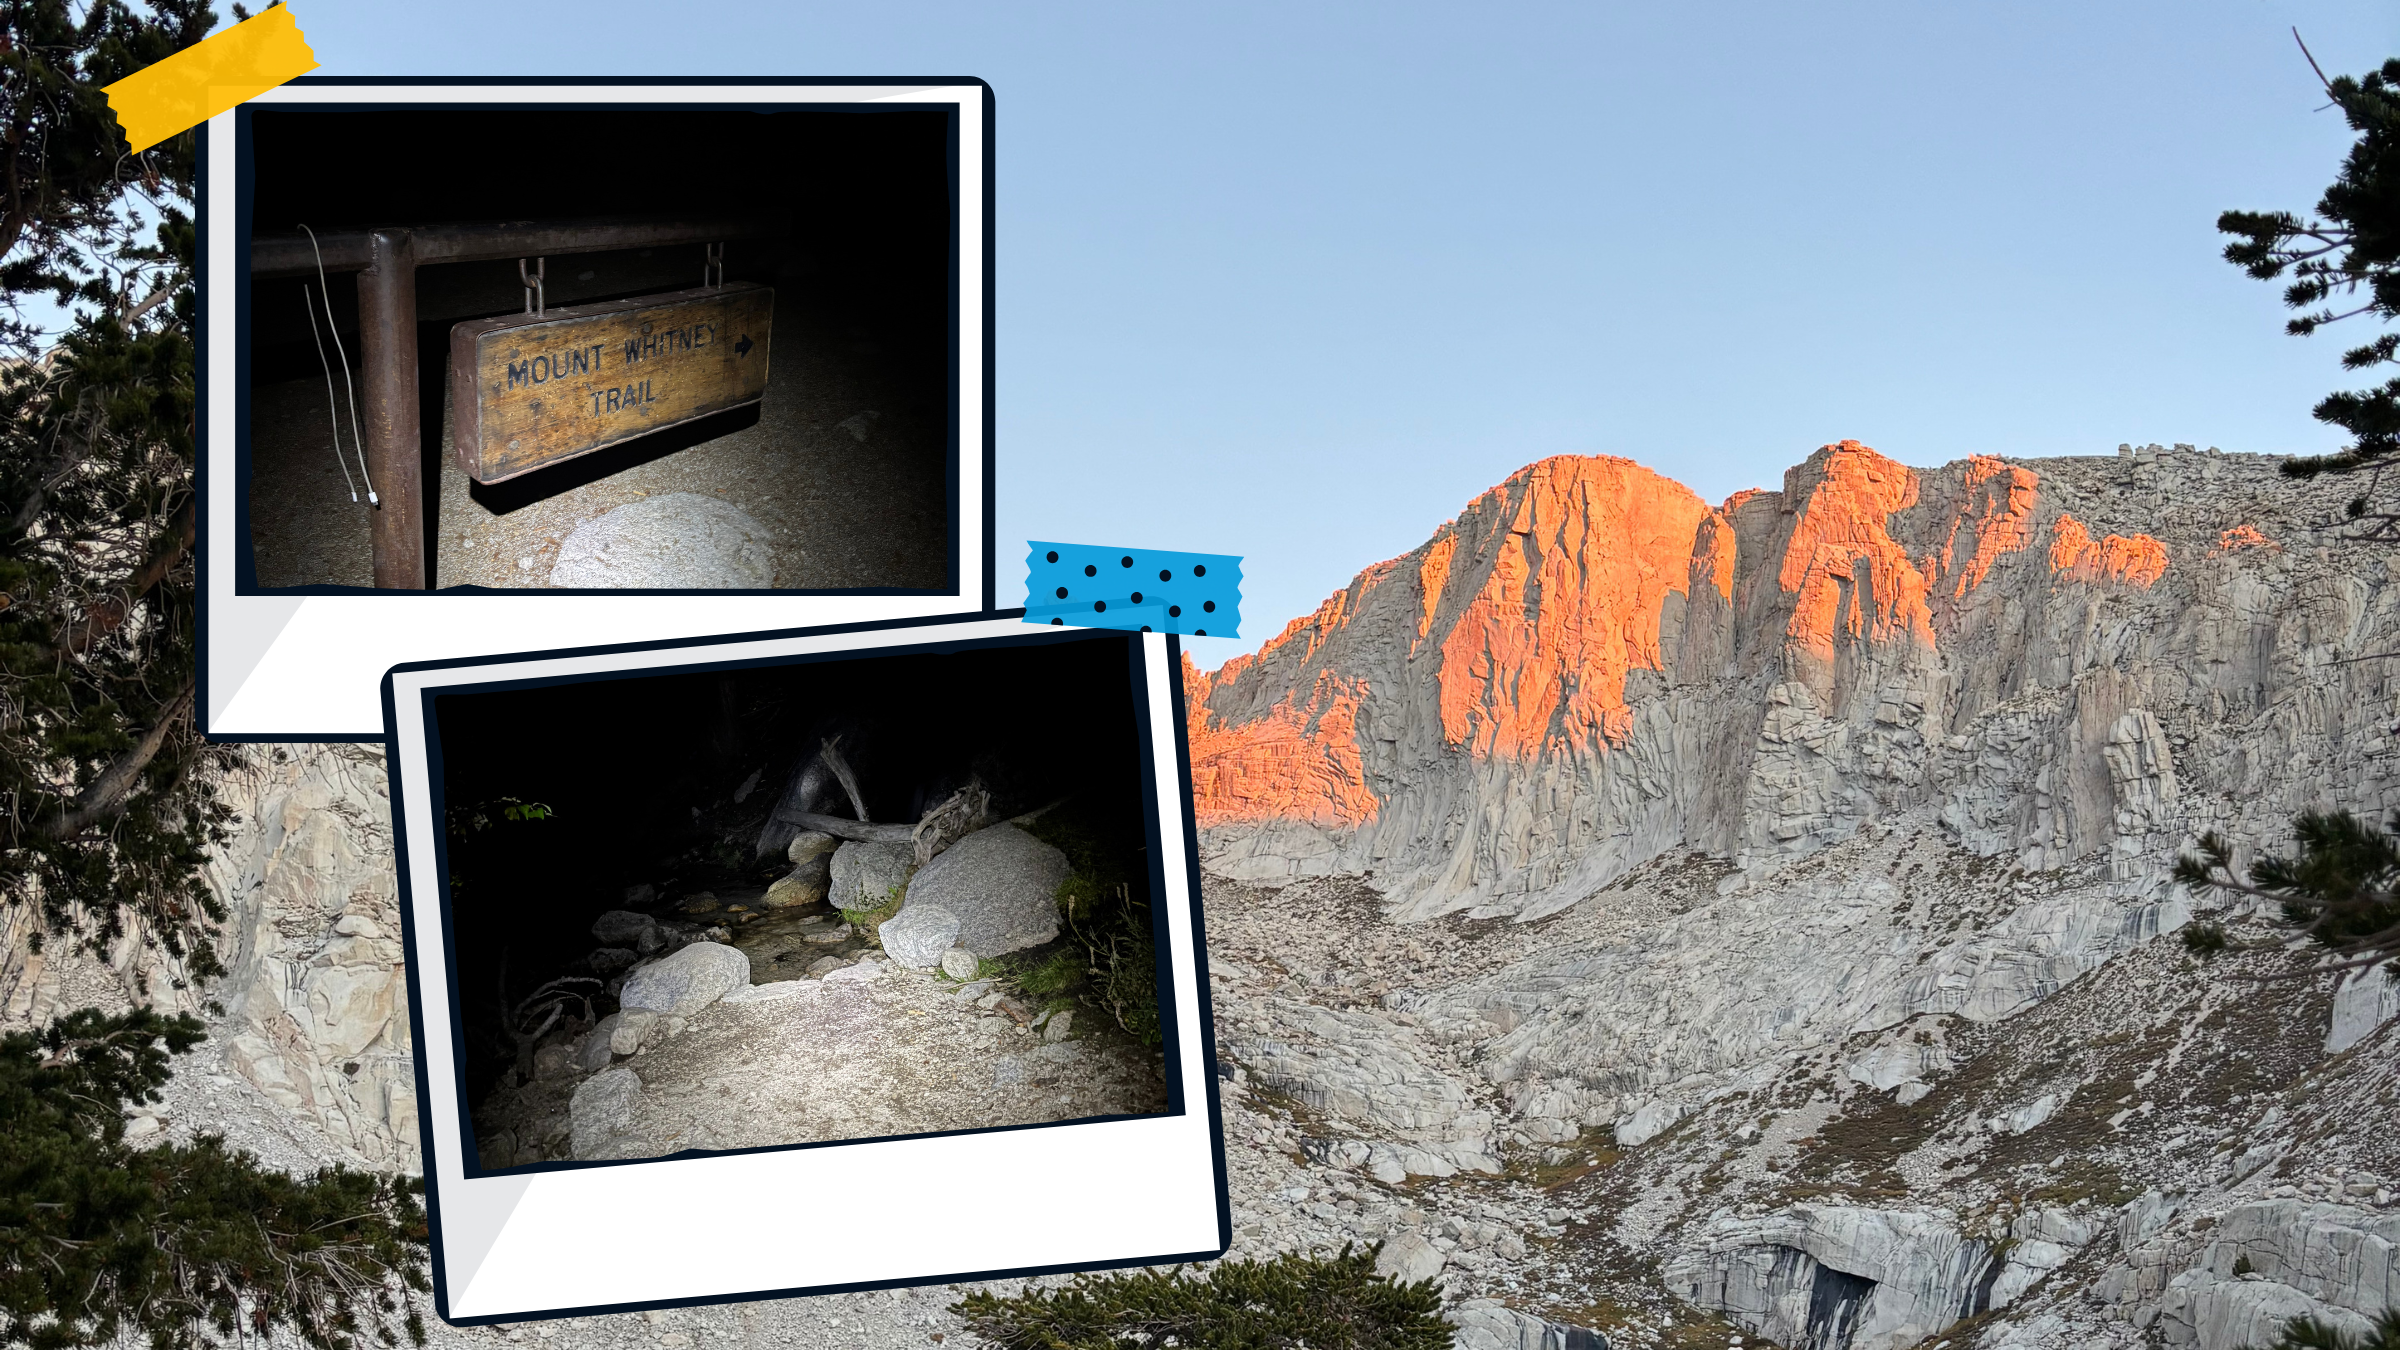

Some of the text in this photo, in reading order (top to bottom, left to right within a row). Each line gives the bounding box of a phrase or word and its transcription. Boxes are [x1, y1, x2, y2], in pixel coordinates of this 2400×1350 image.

[508, 322, 719, 391] MOUNT WHITNEY
[590, 379, 656, 418] TRAIL
